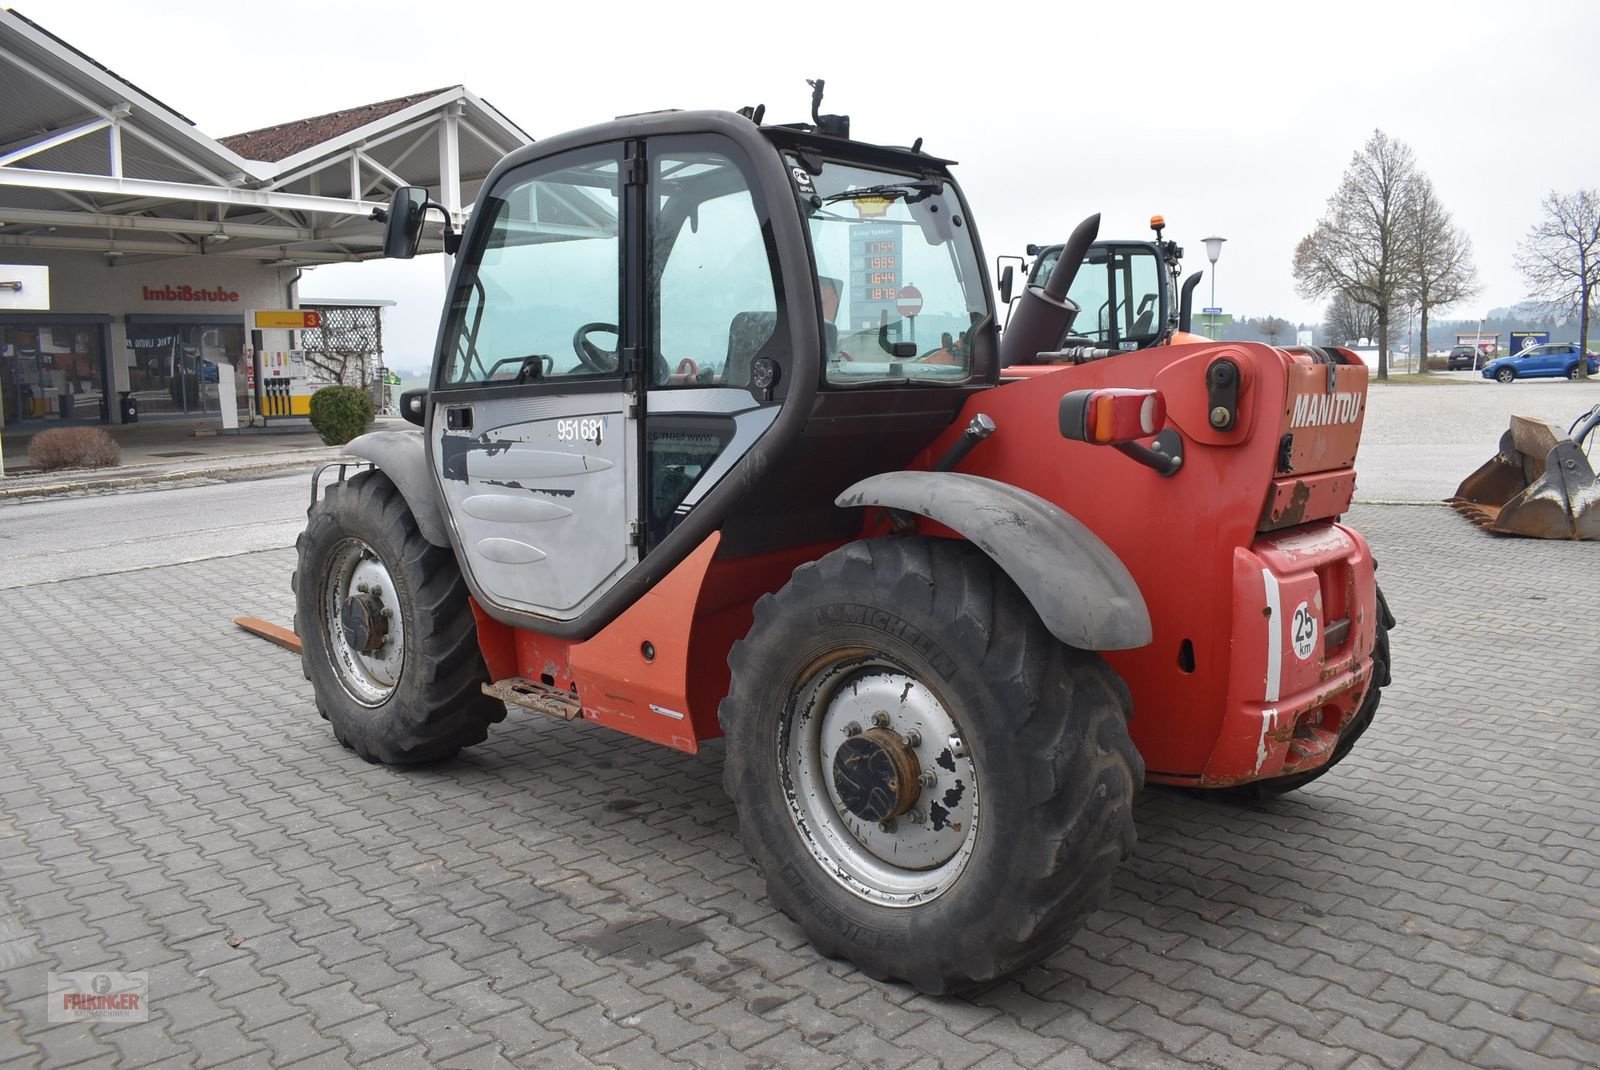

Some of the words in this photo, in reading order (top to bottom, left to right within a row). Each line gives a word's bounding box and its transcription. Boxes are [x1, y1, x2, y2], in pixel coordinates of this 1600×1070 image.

[143, 284, 240, 302] Imbißstube
[307, 314, 316, 326] 3
[1290, 392, 1362, 428] MANITOU
[557, 419, 603, 440] 951681
[1295, 608, 1313, 642] 25
[1300, 643, 1311, 656] km
